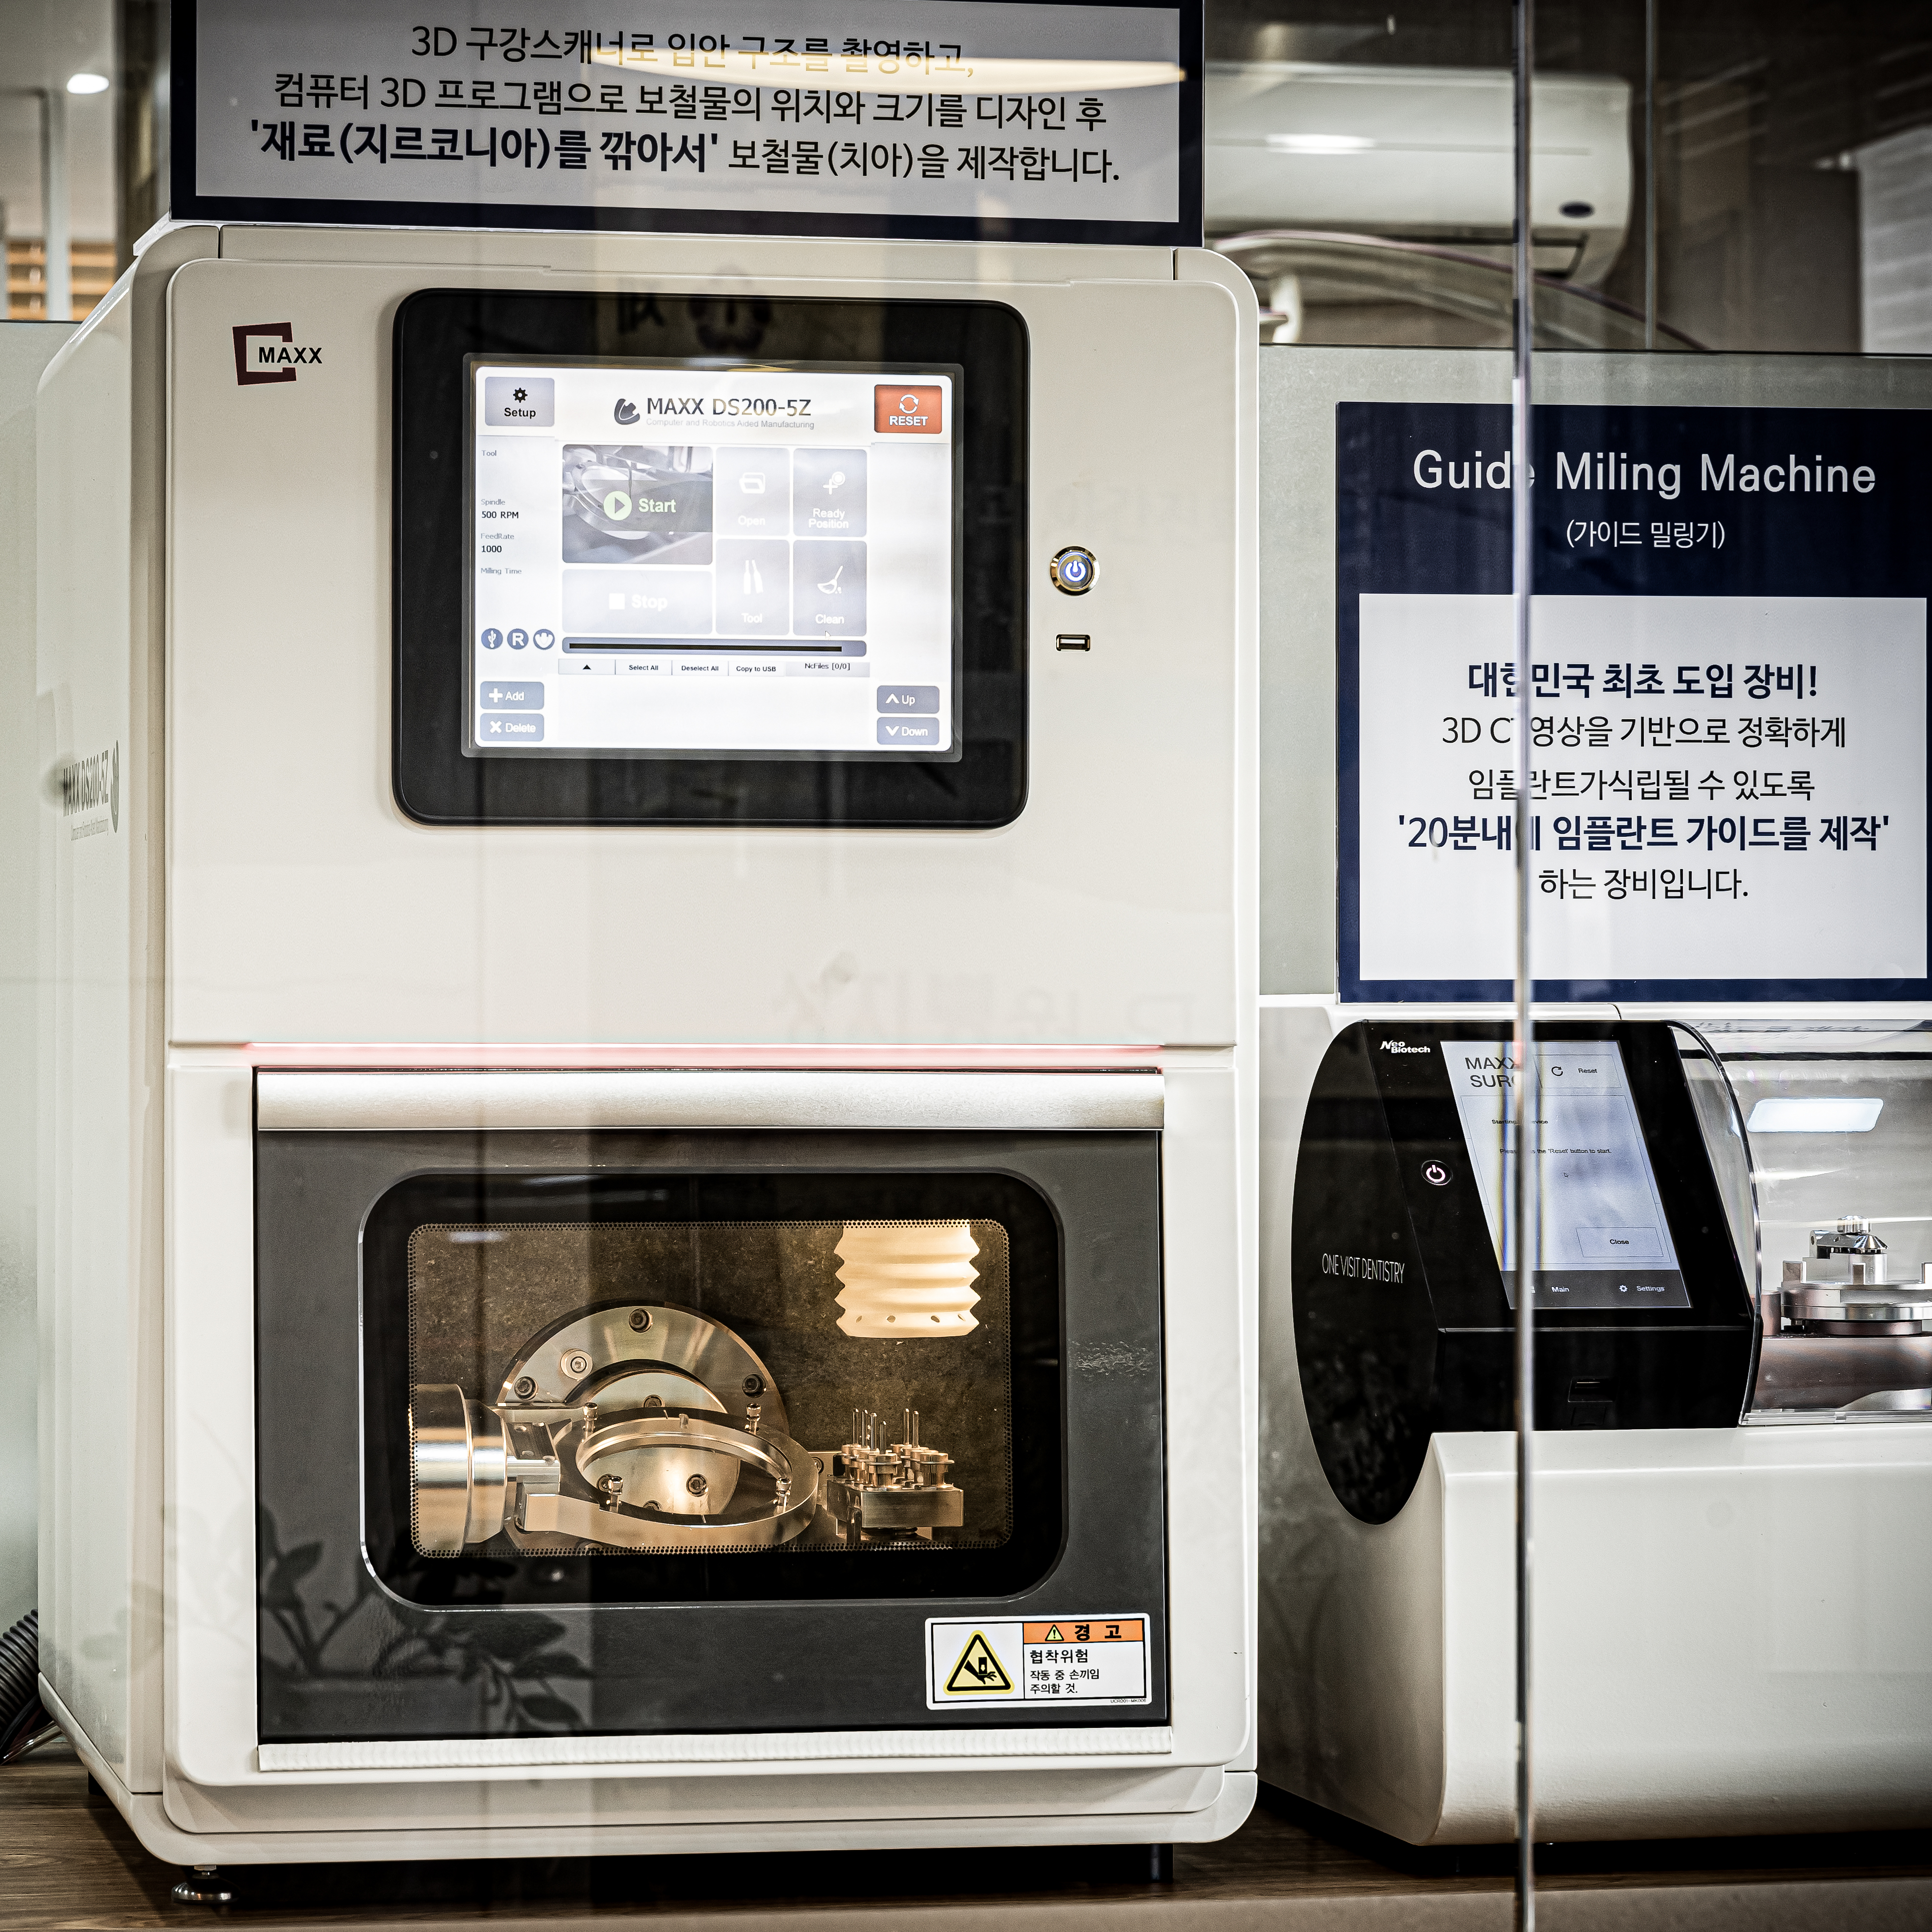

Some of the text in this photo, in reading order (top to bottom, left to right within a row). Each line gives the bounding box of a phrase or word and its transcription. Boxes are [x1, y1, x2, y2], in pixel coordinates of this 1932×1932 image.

[412, 26, 974, 77] 3D 구강스캐너로 입안 구조를 촬영하고,
[274, 73, 1107, 132] 컴퓨터 3D 프로그램으로 보철물의 위치와 크기를 디자인 후
[251, 119, 1119, 183] '재료(지르코니아)를 깎아서' 보철물(치아)을 제작합니다.
[259, 346, 323, 364] MAXX
[504, 407, 536, 419] Setup
[647, 397, 811, 416] MAXX DS200-5Z
[646, 418, 684, 427] Computer
[761, 420, 814, 430] Manufacturing
[889, 415, 929, 426] RESET
[1557, 452, 1681, 499] Miling
[1702, 454, 1875, 493] Machine
[638, 498, 676, 513] Start
[812, 508, 846, 520] Ready
[738, 515, 766, 527] Open
[809, 519, 849, 529] Position
[1567, 519, 1725, 549] (가이드 밀링기)
[631, 594, 668, 611] Stop
[741, 612, 763, 623] Tool
[815, 614, 845, 625] Clean
[832, 663, 850, 671] [0/0]
[1602, 663, 1665, 699] 최초
[1673, 664, 1733, 699] 도입
[1743, 664, 1817, 700] 장비!
[505, 691, 524, 701] Add
[901, 695, 915, 706] Up
[505, 723, 536, 733] Delete
[901, 727, 928, 736] Down
[1442, 716, 1845, 748] 3D C 영상을 기반으로 정확하게
[1698, 770, 1725, 801] 수
[1733, 770, 1815, 801] 있도록
[1553, 815, 1678, 851] 임플란트
[1686, 815, 1811, 851] 가이드를
[1819, 815, 1889, 851] 제작'
[1538, 869, 1748, 900] 하는 장비입니다.
[1379, 1040, 1405, 1049] Neo
[1470, 1075, 1515, 1087] SUR
[1322, 1253, 1405, 1284] ONE VISIT DENTISTRY
[1030, 1649, 1088, 1664] 협착위험
[1030, 1668, 1099, 1681] 작동 중 손끼임
[1030, 1683, 1078, 1694] 주의할 것.
